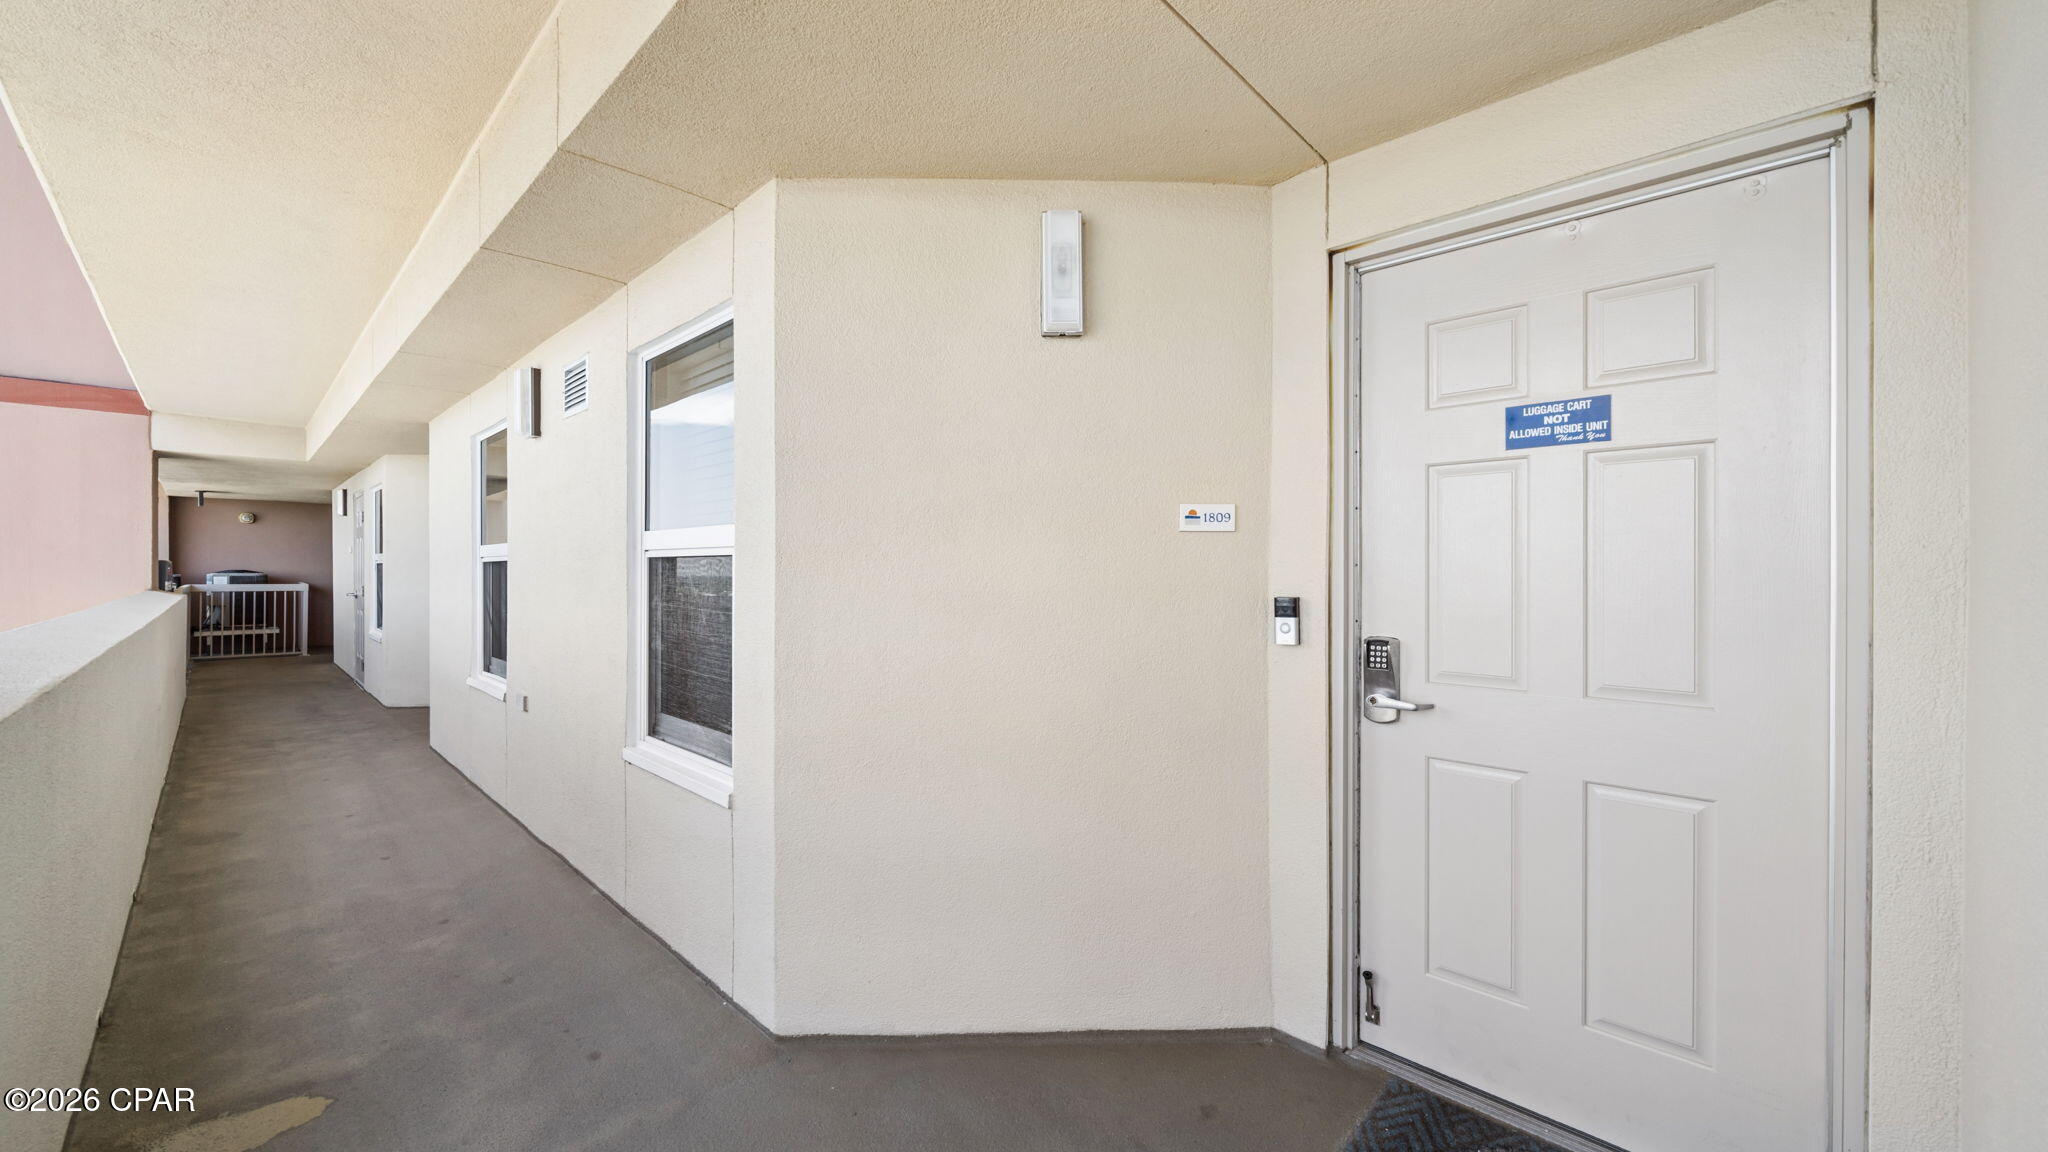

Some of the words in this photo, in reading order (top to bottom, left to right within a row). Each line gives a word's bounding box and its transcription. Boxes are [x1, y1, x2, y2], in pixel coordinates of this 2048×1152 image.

[1523, 403, 1565, 416] LUGGAGE
[1567, 400, 1592, 411] CART
[1543, 413, 1571, 425] NOT
[1509, 427, 1551, 439] ALLOWED
[1554, 423, 1583, 435] INSIDE
[1586, 420, 1608, 431] UNIT
[1556, 434, 1584, 442] Thank
[1586, 431, 1606, 440] You
[1203, 512, 1231, 523] 1809
